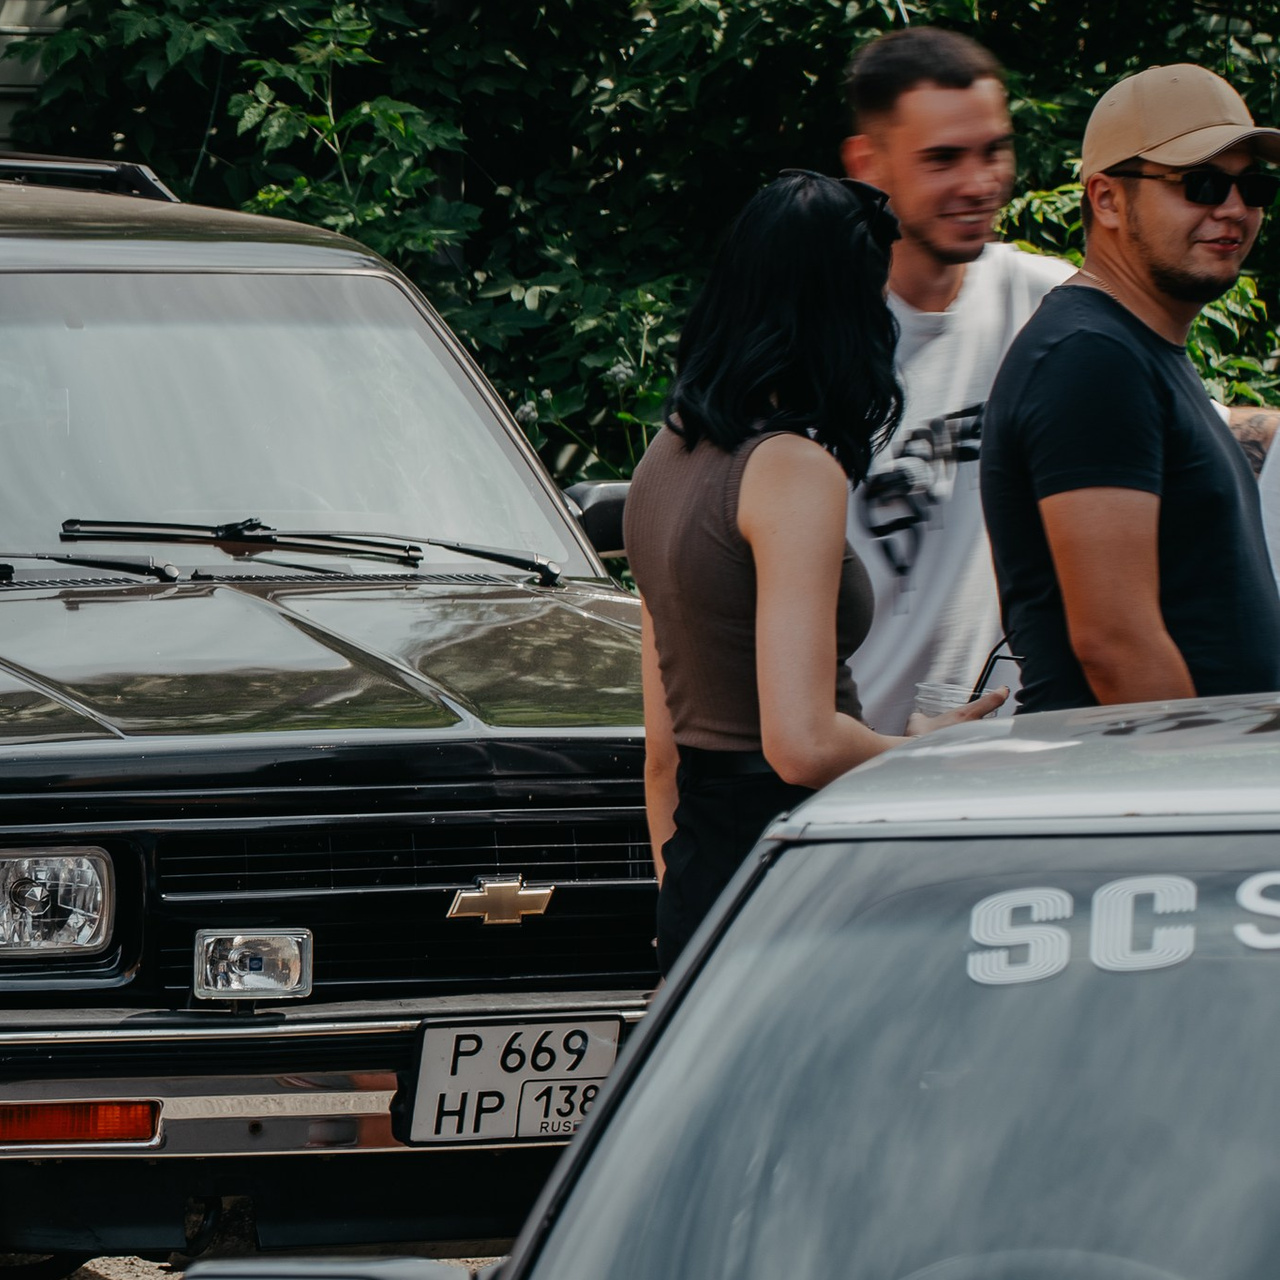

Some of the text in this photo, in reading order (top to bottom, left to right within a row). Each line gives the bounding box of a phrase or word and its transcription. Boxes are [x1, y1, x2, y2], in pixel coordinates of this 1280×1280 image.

[966, 873, 1197, 985] SC
[499, 1029, 588, 1073] 669
[533, 1084, 600, 1118] 138
[539, 1120, 572, 1133] RUS
